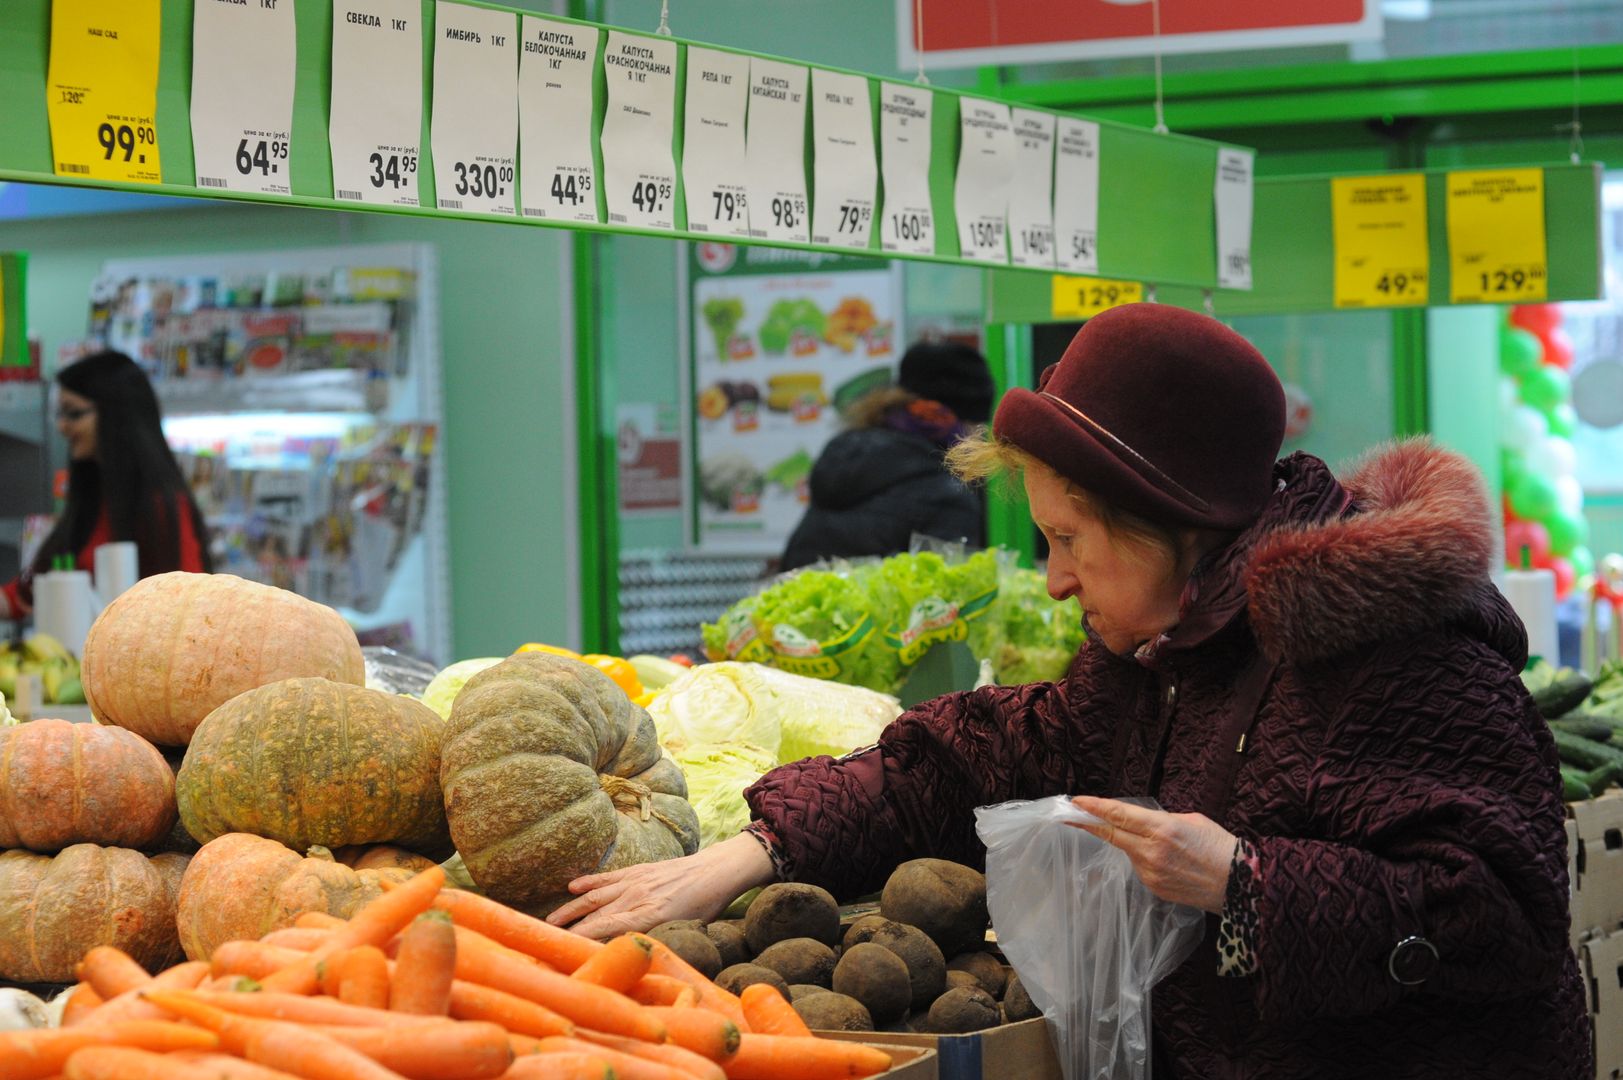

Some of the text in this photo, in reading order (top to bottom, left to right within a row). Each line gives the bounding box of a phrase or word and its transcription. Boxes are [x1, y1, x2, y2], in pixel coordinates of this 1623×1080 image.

[346, 11, 407, 31] СВЕКЛА 1КГ
[446, 27, 506, 47] ИМБИРЬ 1КГ
[538, 30, 574, 46] КАПУСТА
[525, 41, 587, 61] БЕЛОКОЧАННАЯ
[621, 44, 654, 60] КАПУСТА
[548, 58, 563, 70] 1КГ
[606, 54, 671, 75] КРАСНОКОЧАННА
[635, 71, 647, 83] 1КГ
[702, 71, 719, 83] РЕПА
[98, 123, 155, 164] 99.90
[236, 139, 288, 176] 64.95
[369, 152, 417, 189] 34.95
[454, 161, 514, 199] 330.00
[551, 173, 591, 206] 44.95
[632, 182, 671, 213] 49.95
[712, 191, 747, 221] 79.95
[771, 198, 805, 228] 98.95
[837, 205, 871, 234] 79.95
[1021, 230, 1053, 255] 140.
[1073, 235, 1095, 259] 54.
